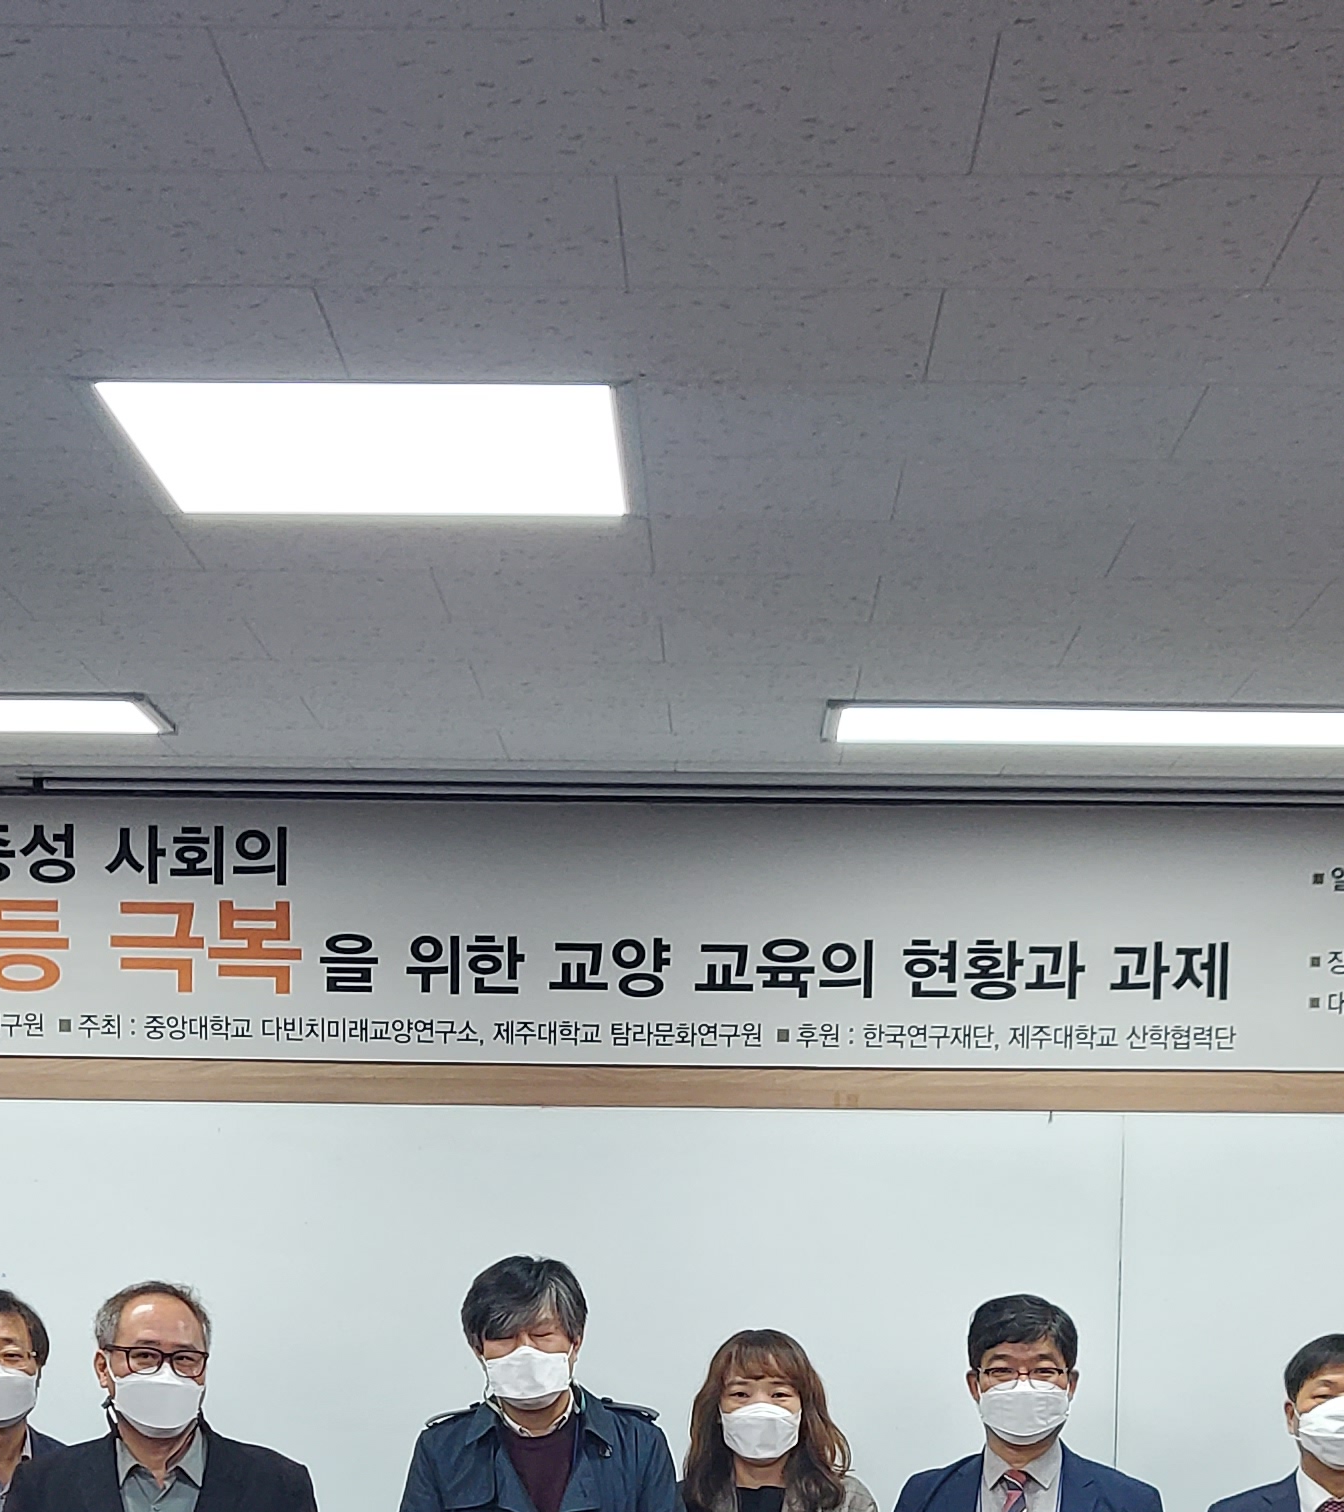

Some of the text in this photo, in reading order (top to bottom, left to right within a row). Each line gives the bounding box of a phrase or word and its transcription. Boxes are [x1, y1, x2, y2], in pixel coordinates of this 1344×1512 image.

[104, 824, 288, 887] 사회의
[110, 900, 302, 995] 극복
[319, 933, 379, 993] 을
[405, 934, 526, 995] 위한
[548, 937, 671, 998] 교양
[694, 938, 874, 999] 교육의
[902, 939, 1086, 1001] 현황과
[1109, 941, 1229, 1001] 과제
[78, 1014, 121, 1039] 주최
[143, 1015, 253, 1041] 중앙대학교
[261, 1016, 484, 1047] 다빈치미래교양연구소,
[492, 1020, 602, 1047] 제주대학교
[610, 1021, 762, 1048] 탐라문화연구원
[796, 1023, 840, 1049] 후원
[863, 1023, 999, 1051] 한국연구재단,
[1008, 1024, 1119, 1050] 제주대학교
[1125, 1025, 1237, 1051] 산학협력단
